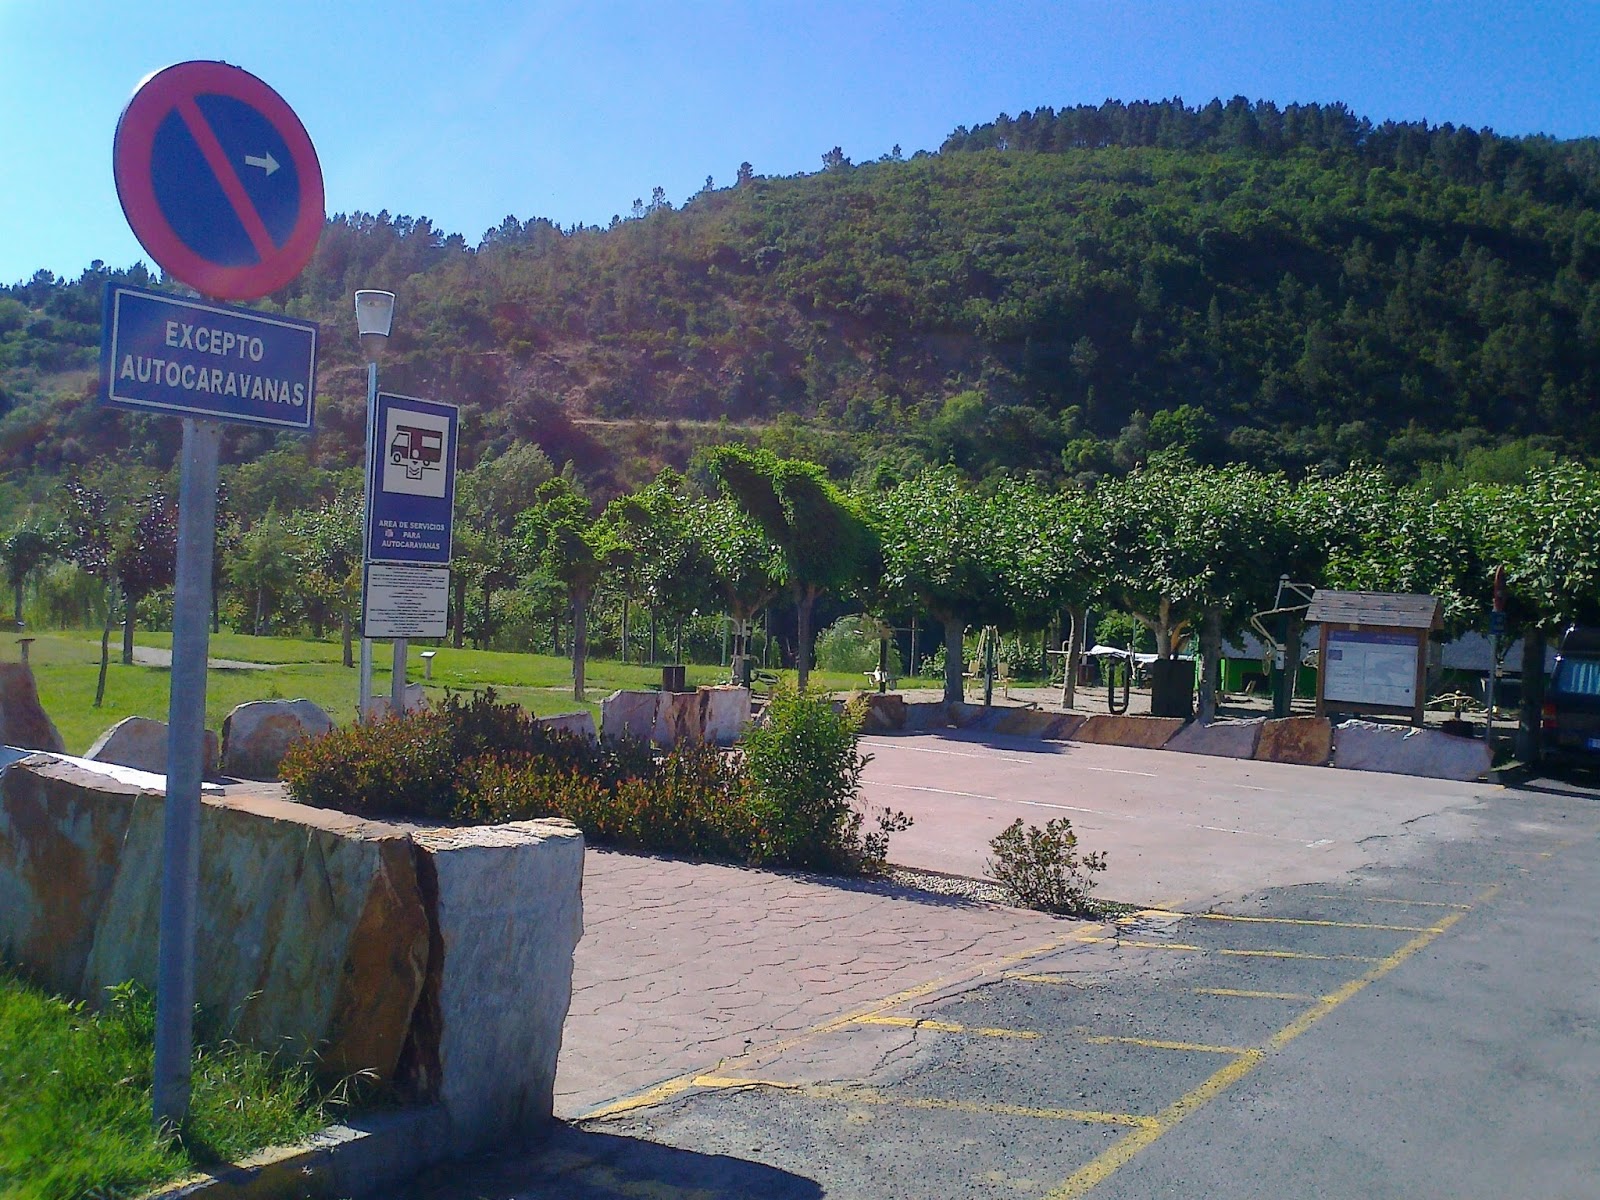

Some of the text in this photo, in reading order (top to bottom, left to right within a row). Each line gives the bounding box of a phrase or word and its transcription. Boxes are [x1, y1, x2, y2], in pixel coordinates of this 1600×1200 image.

[165, 320, 264, 362] EXCEPTO
[120, 354, 305, 407] AUTOCARAVANAS
[378, 519, 445, 531] AREA DE SERVICIOS
[403, 531, 421, 539] PARA
[381, 539, 441, 550] AUTOCARAVANAS
